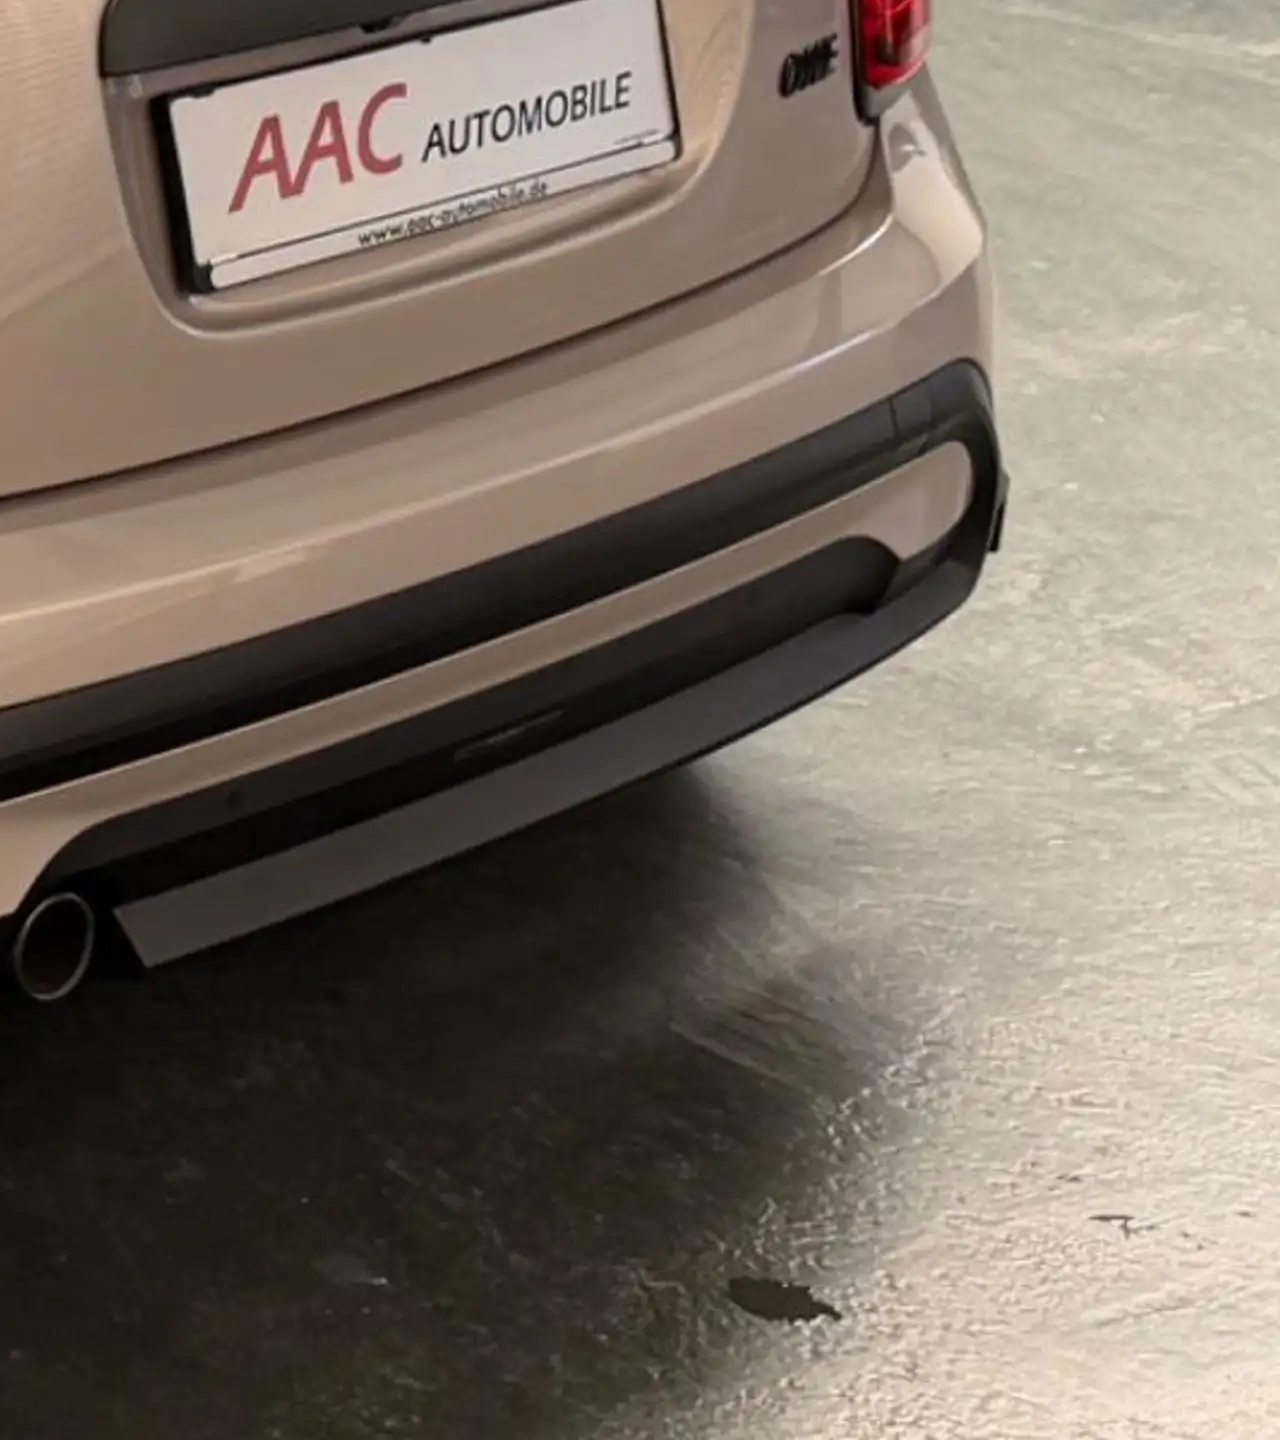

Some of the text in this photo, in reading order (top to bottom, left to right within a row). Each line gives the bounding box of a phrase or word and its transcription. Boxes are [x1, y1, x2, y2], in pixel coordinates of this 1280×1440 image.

[228, 70, 632, 214] AAC AUTOMOBILE
[357, 181, 548, 247] www.aac-automobile.de
